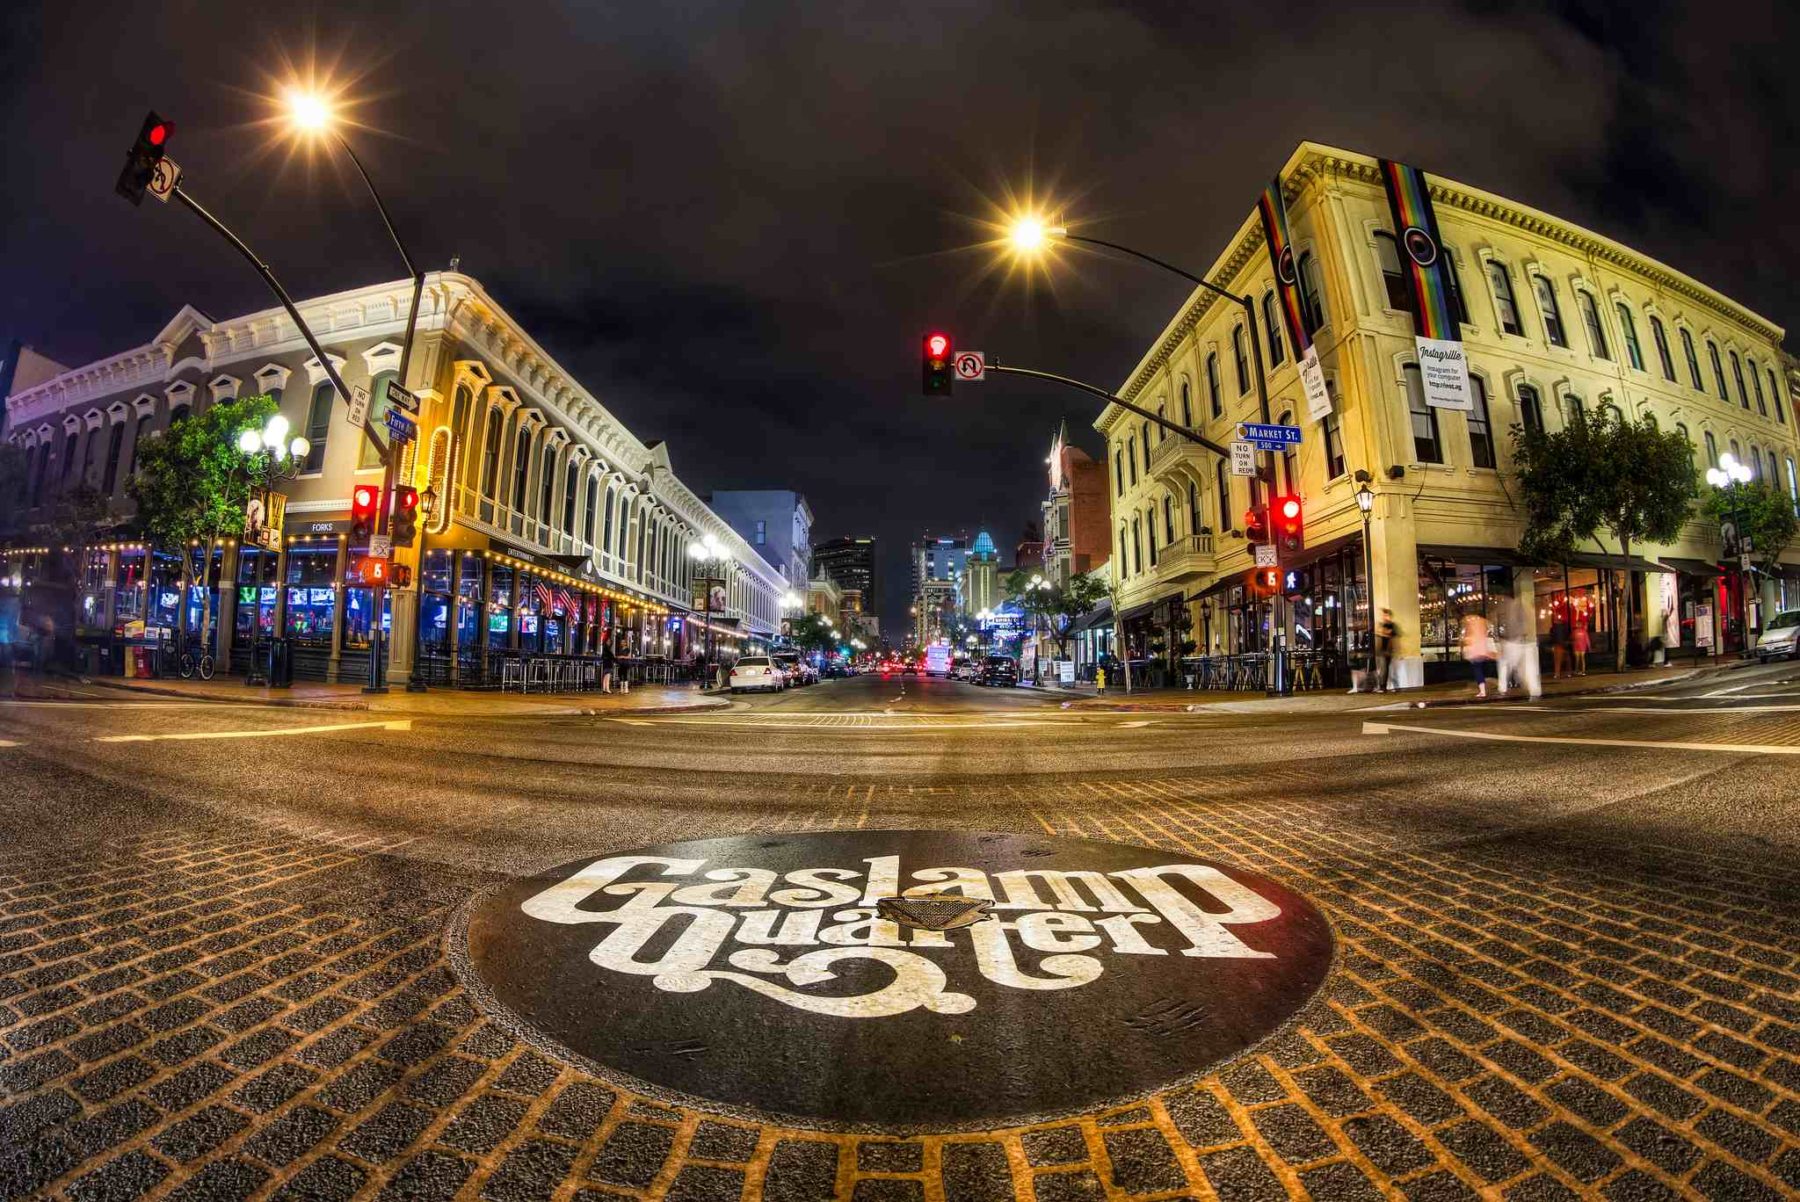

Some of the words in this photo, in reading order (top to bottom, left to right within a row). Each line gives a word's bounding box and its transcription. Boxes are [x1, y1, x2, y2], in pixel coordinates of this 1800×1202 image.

[1420, 347, 1462, 362] Instagrille
[312, 523, 333, 532] FORKS
[521, 855, 1282, 959] Gaslamp
[589, 905, 1168, 1018] Quarter
